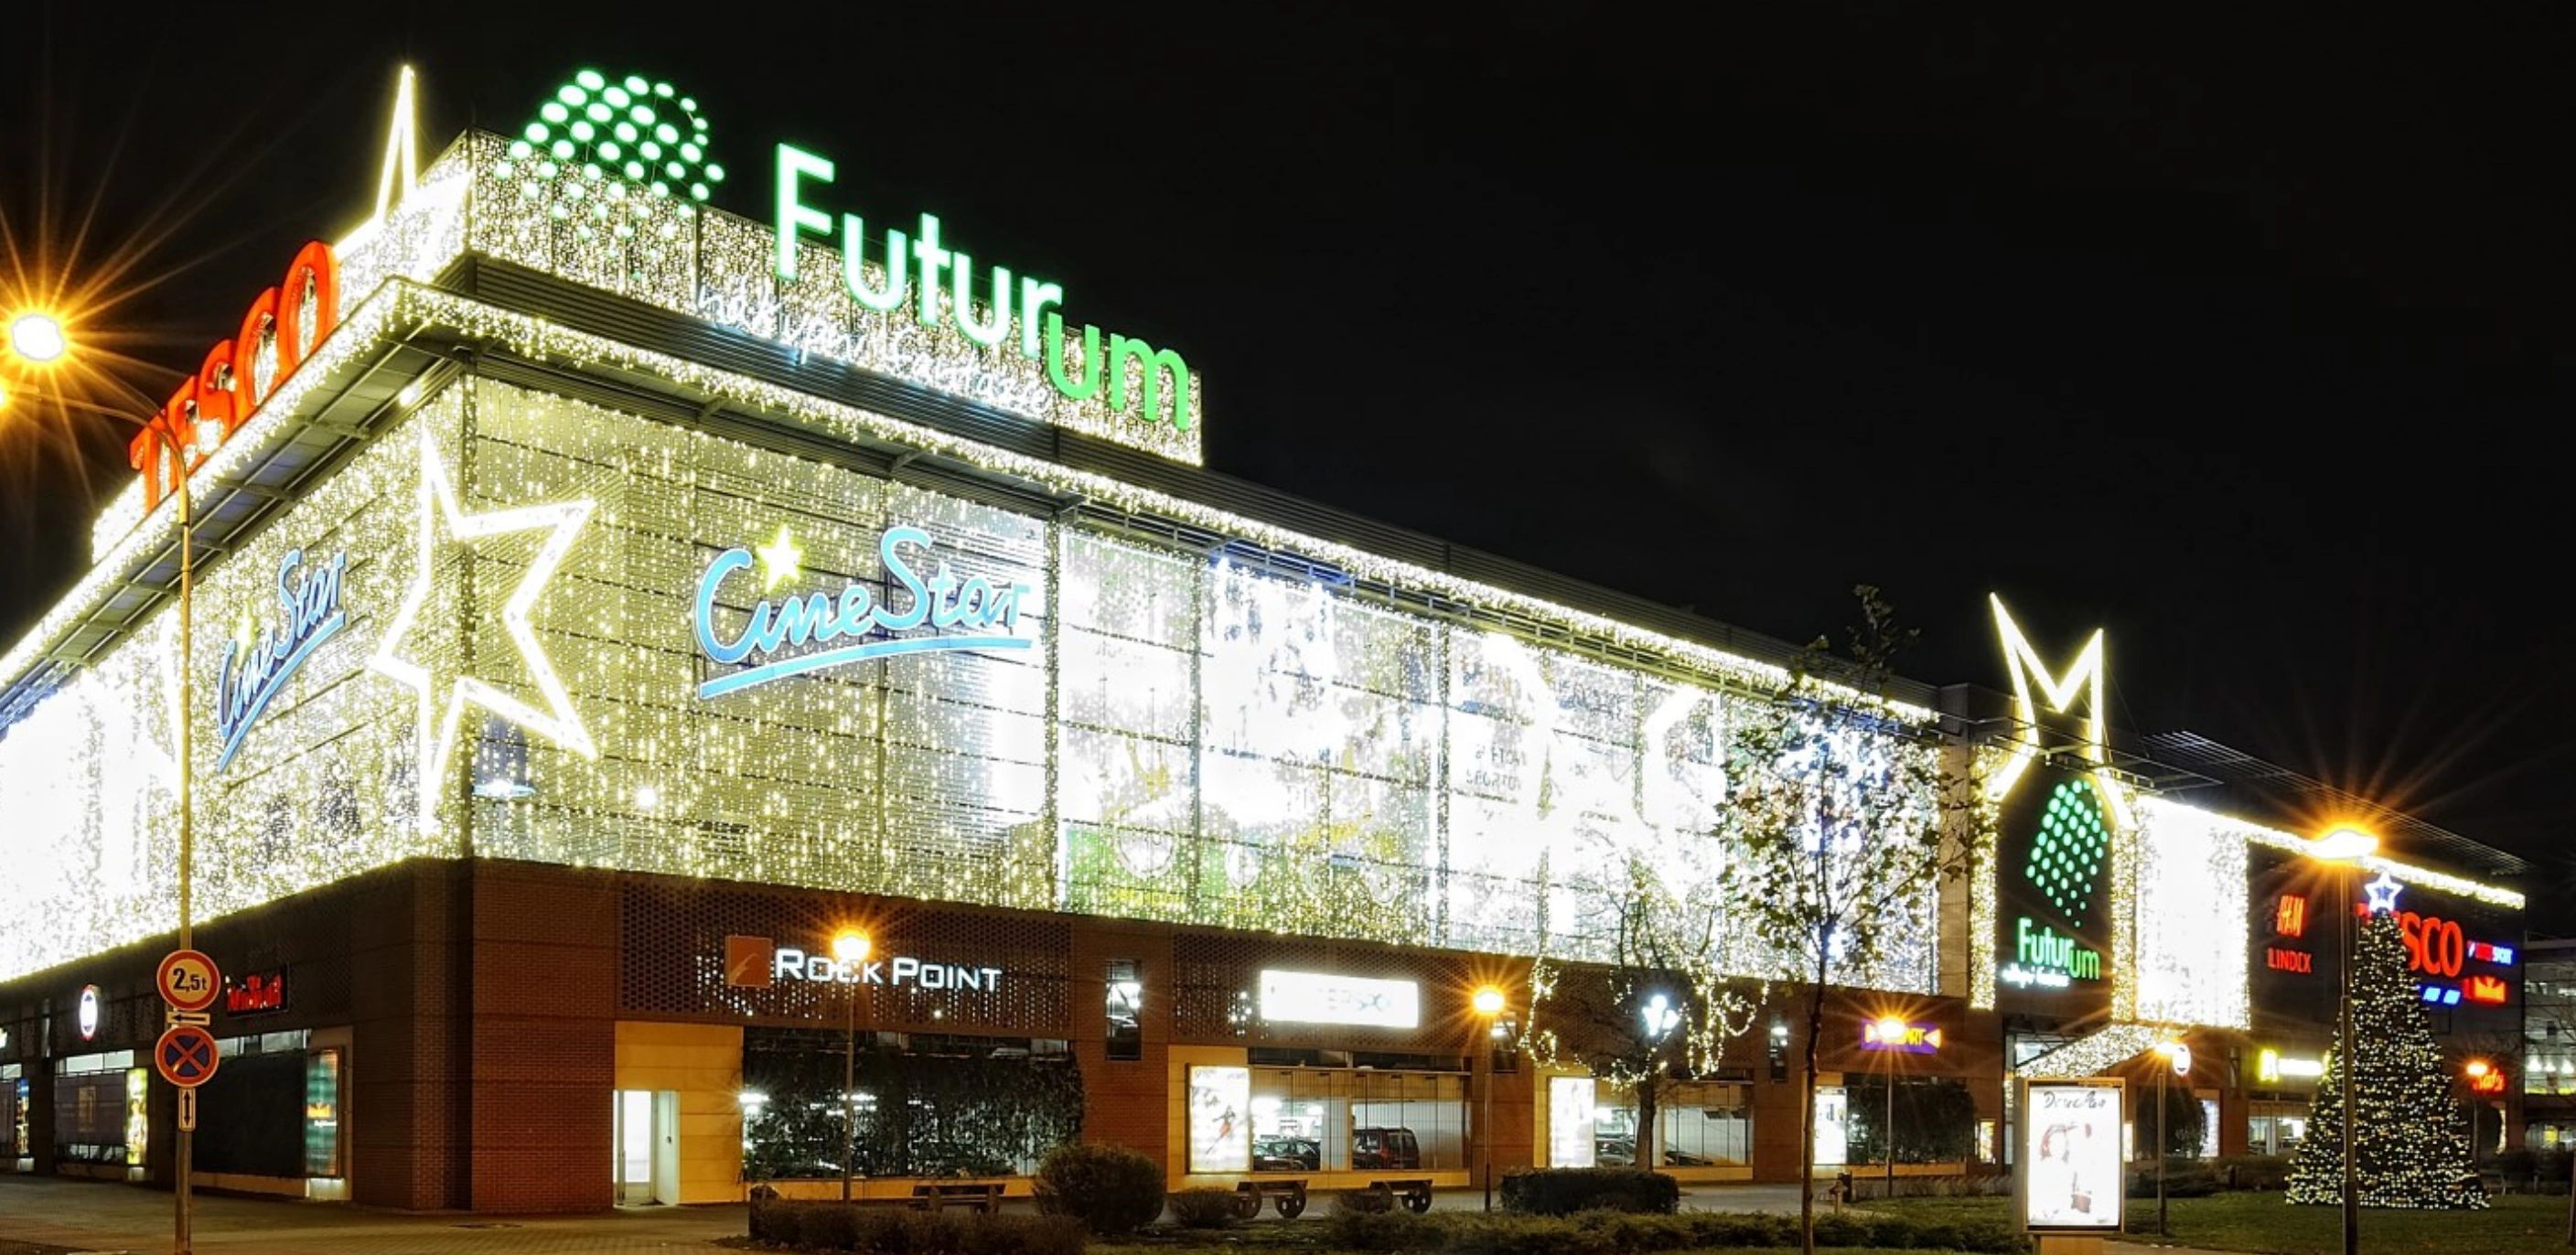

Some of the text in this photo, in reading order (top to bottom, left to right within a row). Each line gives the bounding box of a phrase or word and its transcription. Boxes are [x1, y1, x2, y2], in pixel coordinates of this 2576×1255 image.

[129, 240, 339, 514] TESCO
[775, 141, 1190, 432] Futurum
[219, 548, 347, 739] CineStar
[696, 525, 1031, 664] CineStar
[2017, 917, 2100, 981] Futurum
